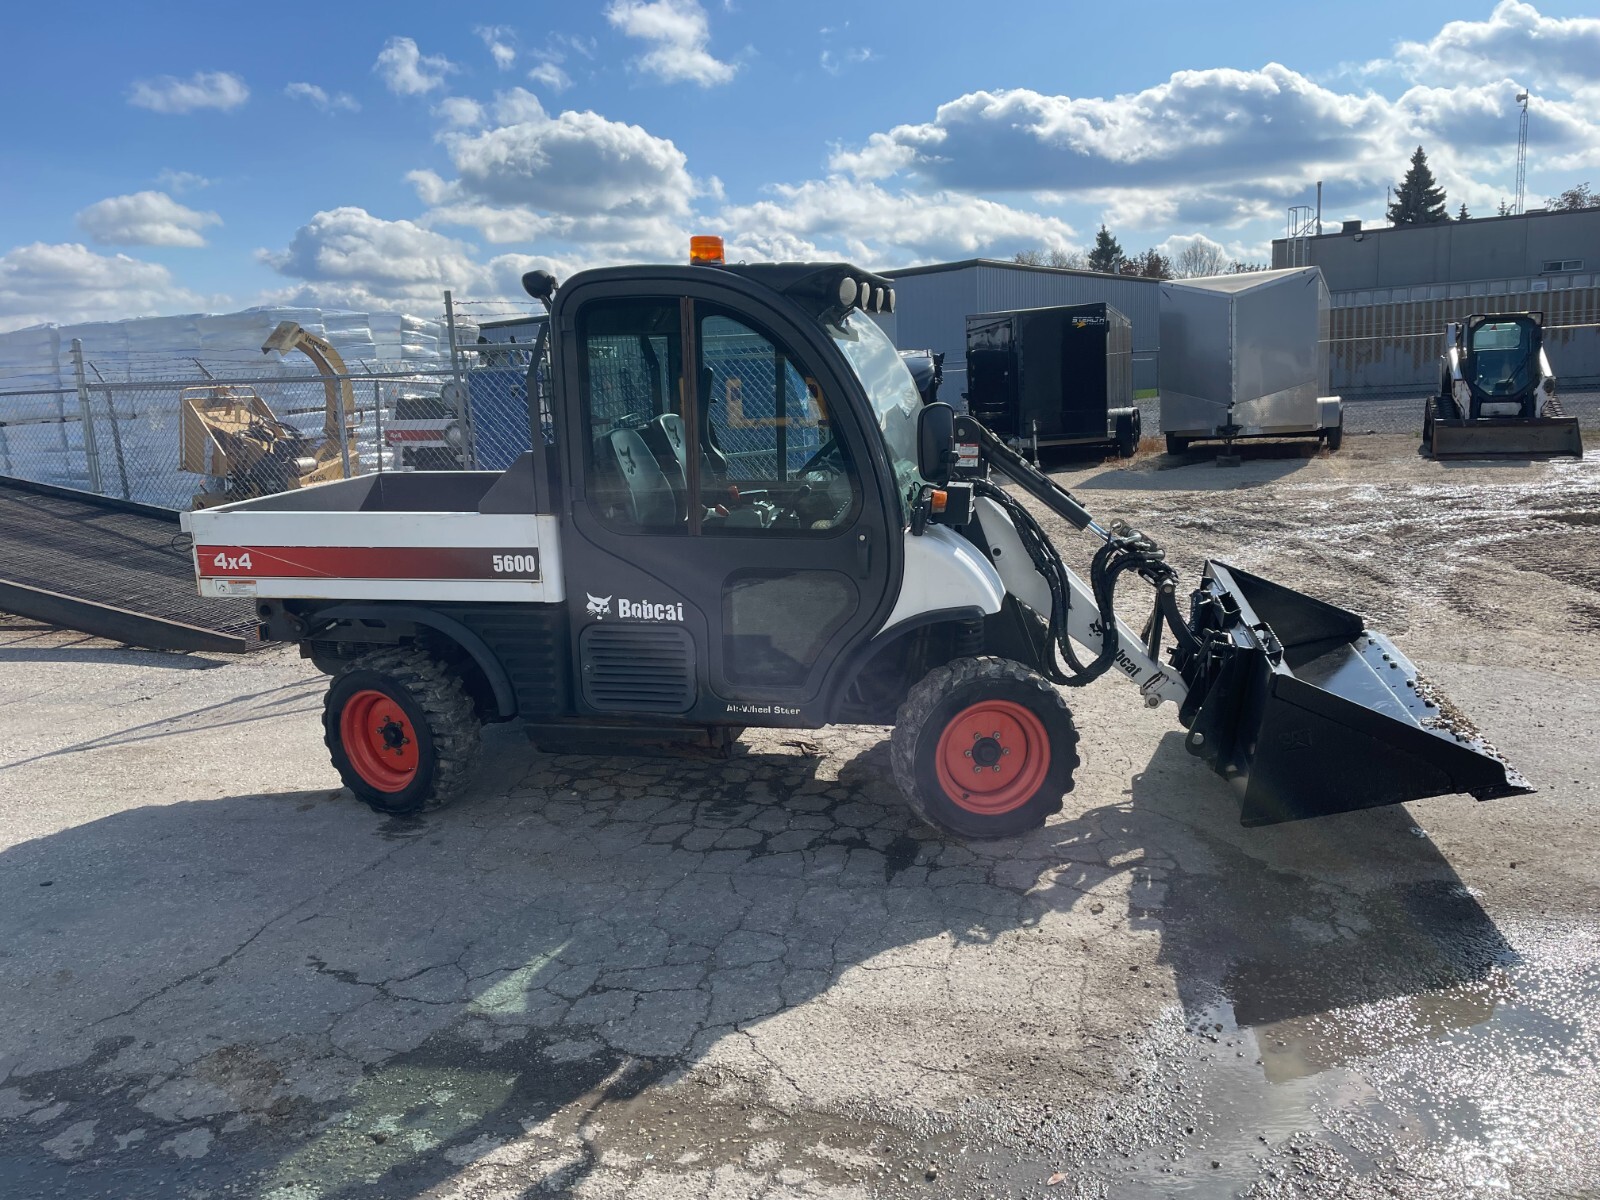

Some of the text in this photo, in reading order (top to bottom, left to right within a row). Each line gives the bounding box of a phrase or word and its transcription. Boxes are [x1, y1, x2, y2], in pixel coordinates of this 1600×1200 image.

[213, 552, 253, 570] 4x4
[492, 554, 536, 573] 5600
[1114, 648, 1143, 678] bcat
[773, 705, 801, 715] Steer
